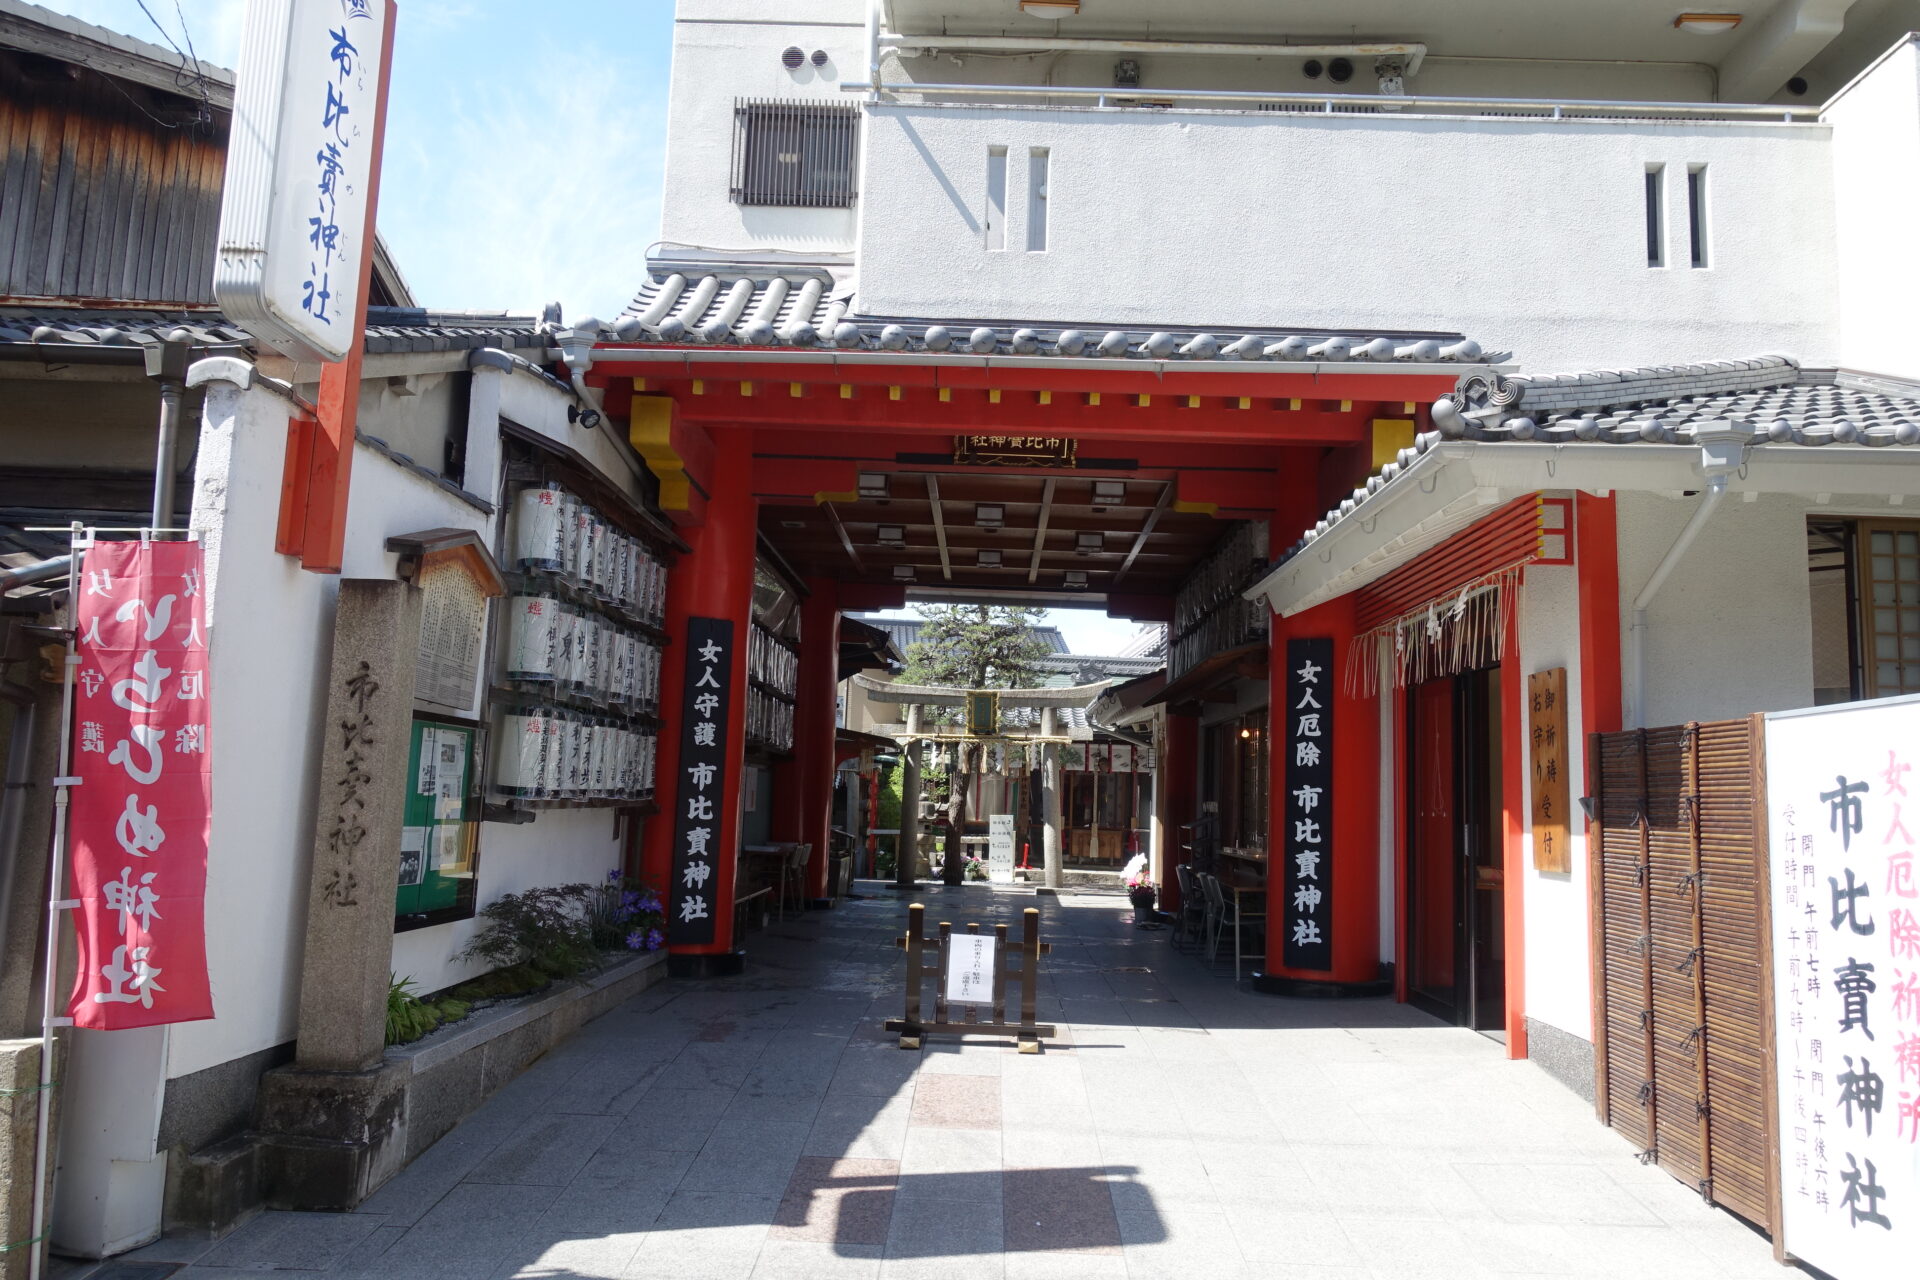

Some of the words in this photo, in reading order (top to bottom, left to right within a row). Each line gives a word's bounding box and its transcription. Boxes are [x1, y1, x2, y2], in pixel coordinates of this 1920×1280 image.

[693, 639, 723, 747] 女人守護
[1296, 660, 1322, 767] 女人厄除
[679, 762, 718, 923] 市比賣神社
[1292, 784, 1323, 947] 市比賣神社
[1819, 775, 1892, 1230] 市比賣神社
